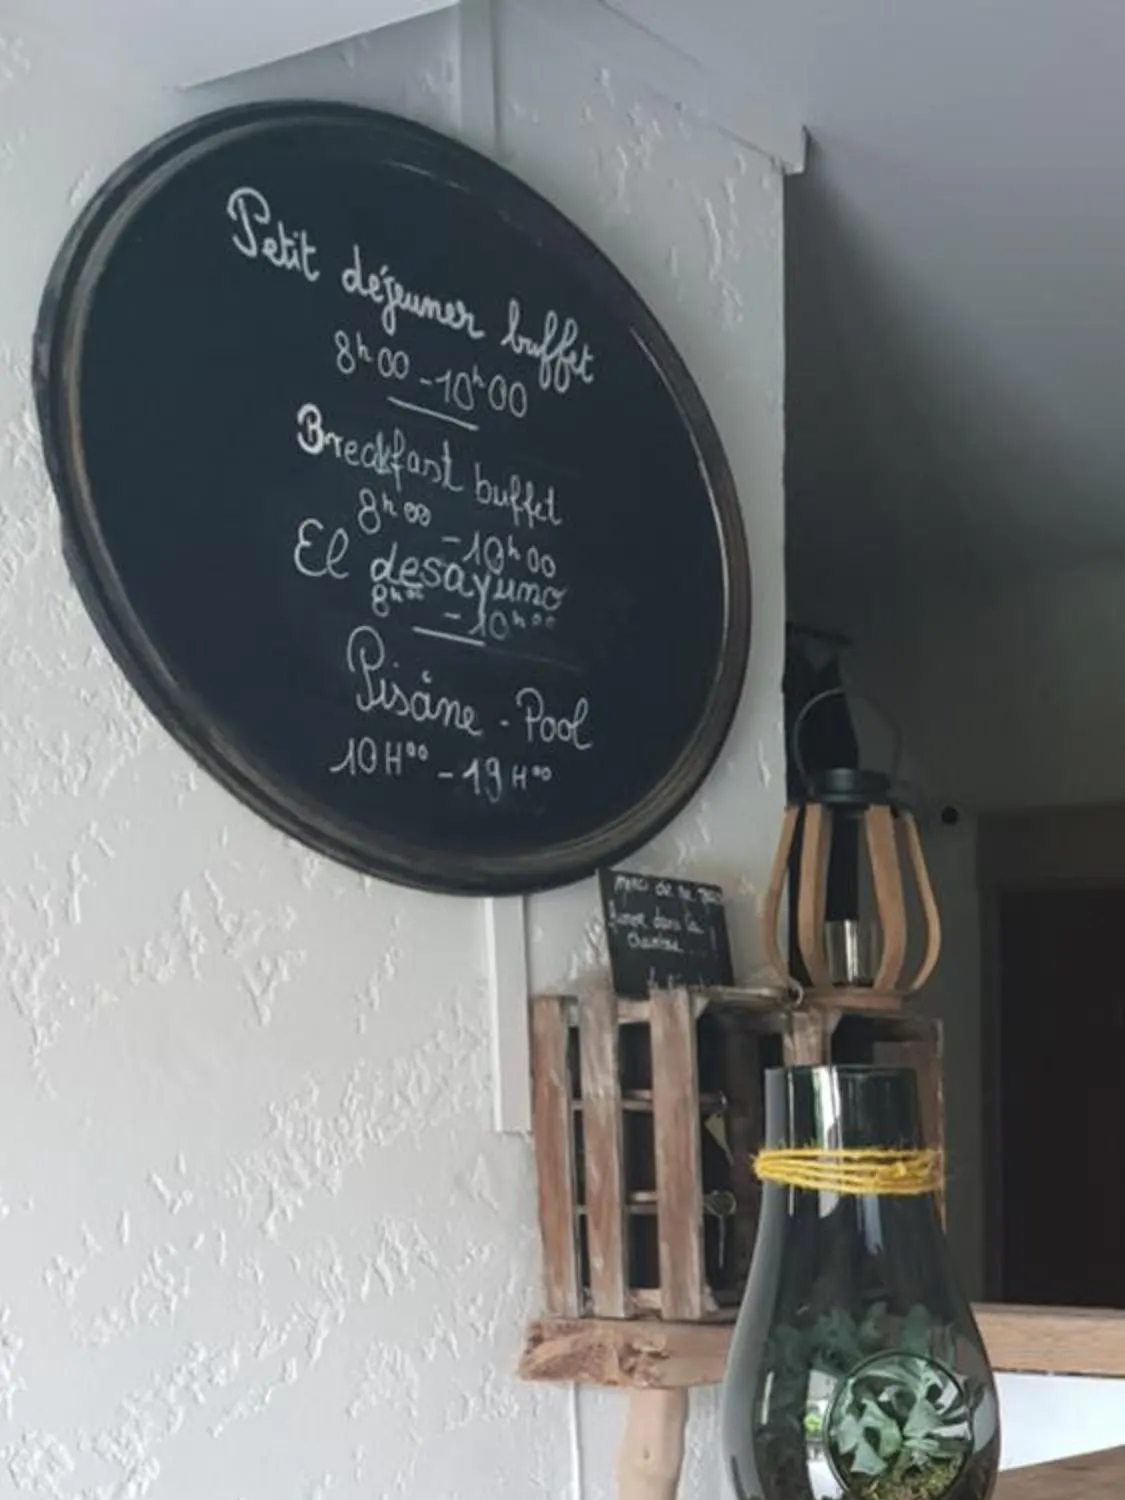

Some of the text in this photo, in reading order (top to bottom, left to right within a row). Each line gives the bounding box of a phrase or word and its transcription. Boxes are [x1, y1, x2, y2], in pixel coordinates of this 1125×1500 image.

[227, 186, 595, 393] Petit déjeuner buffet
[297, 403, 562, 528] Breakfast buffet
[294, 517, 567, 613] El desayuno
[515, 686, 593, 750] Pool
